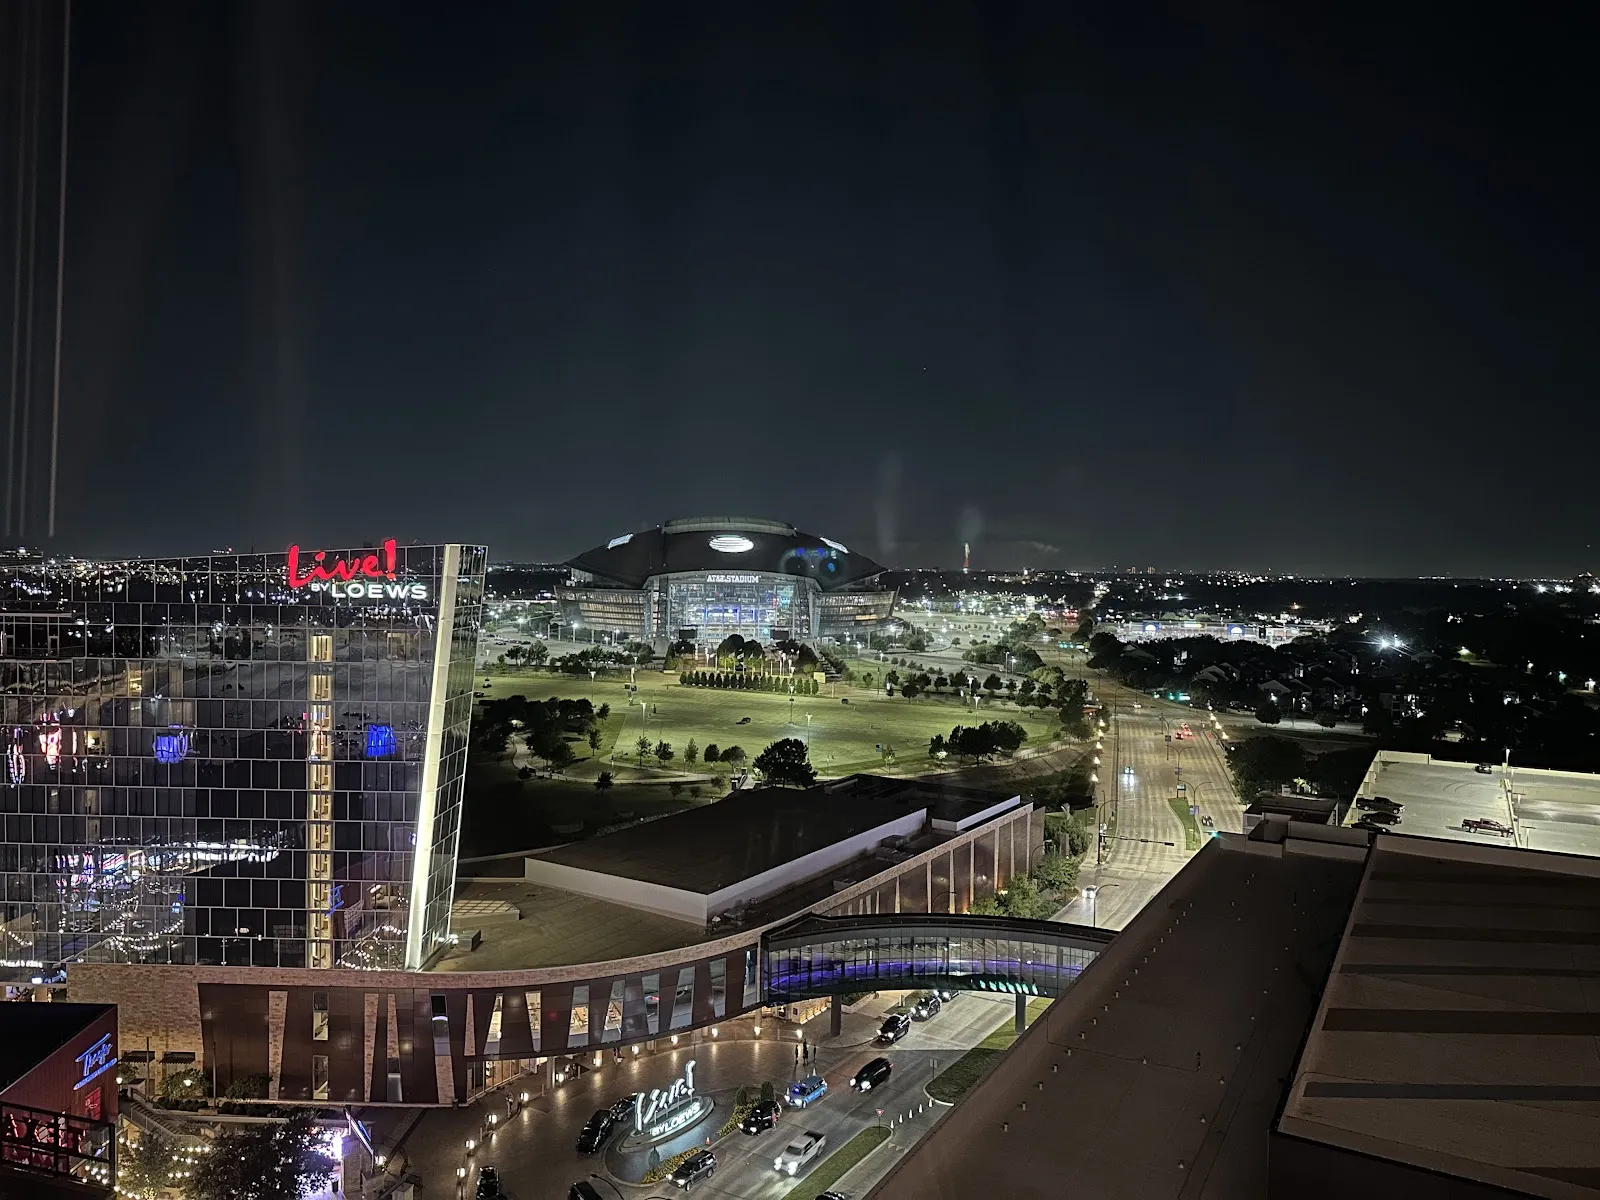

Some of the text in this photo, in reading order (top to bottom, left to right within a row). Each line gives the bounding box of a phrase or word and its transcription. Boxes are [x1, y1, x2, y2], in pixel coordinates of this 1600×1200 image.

[288, 539, 396, 588] Live!
[311, 583, 428, 600] BY LOEWS
[706, 574, 759, 584] AT&T STADIUM
[651, 1101, 701, 1137] BY LOEWS
